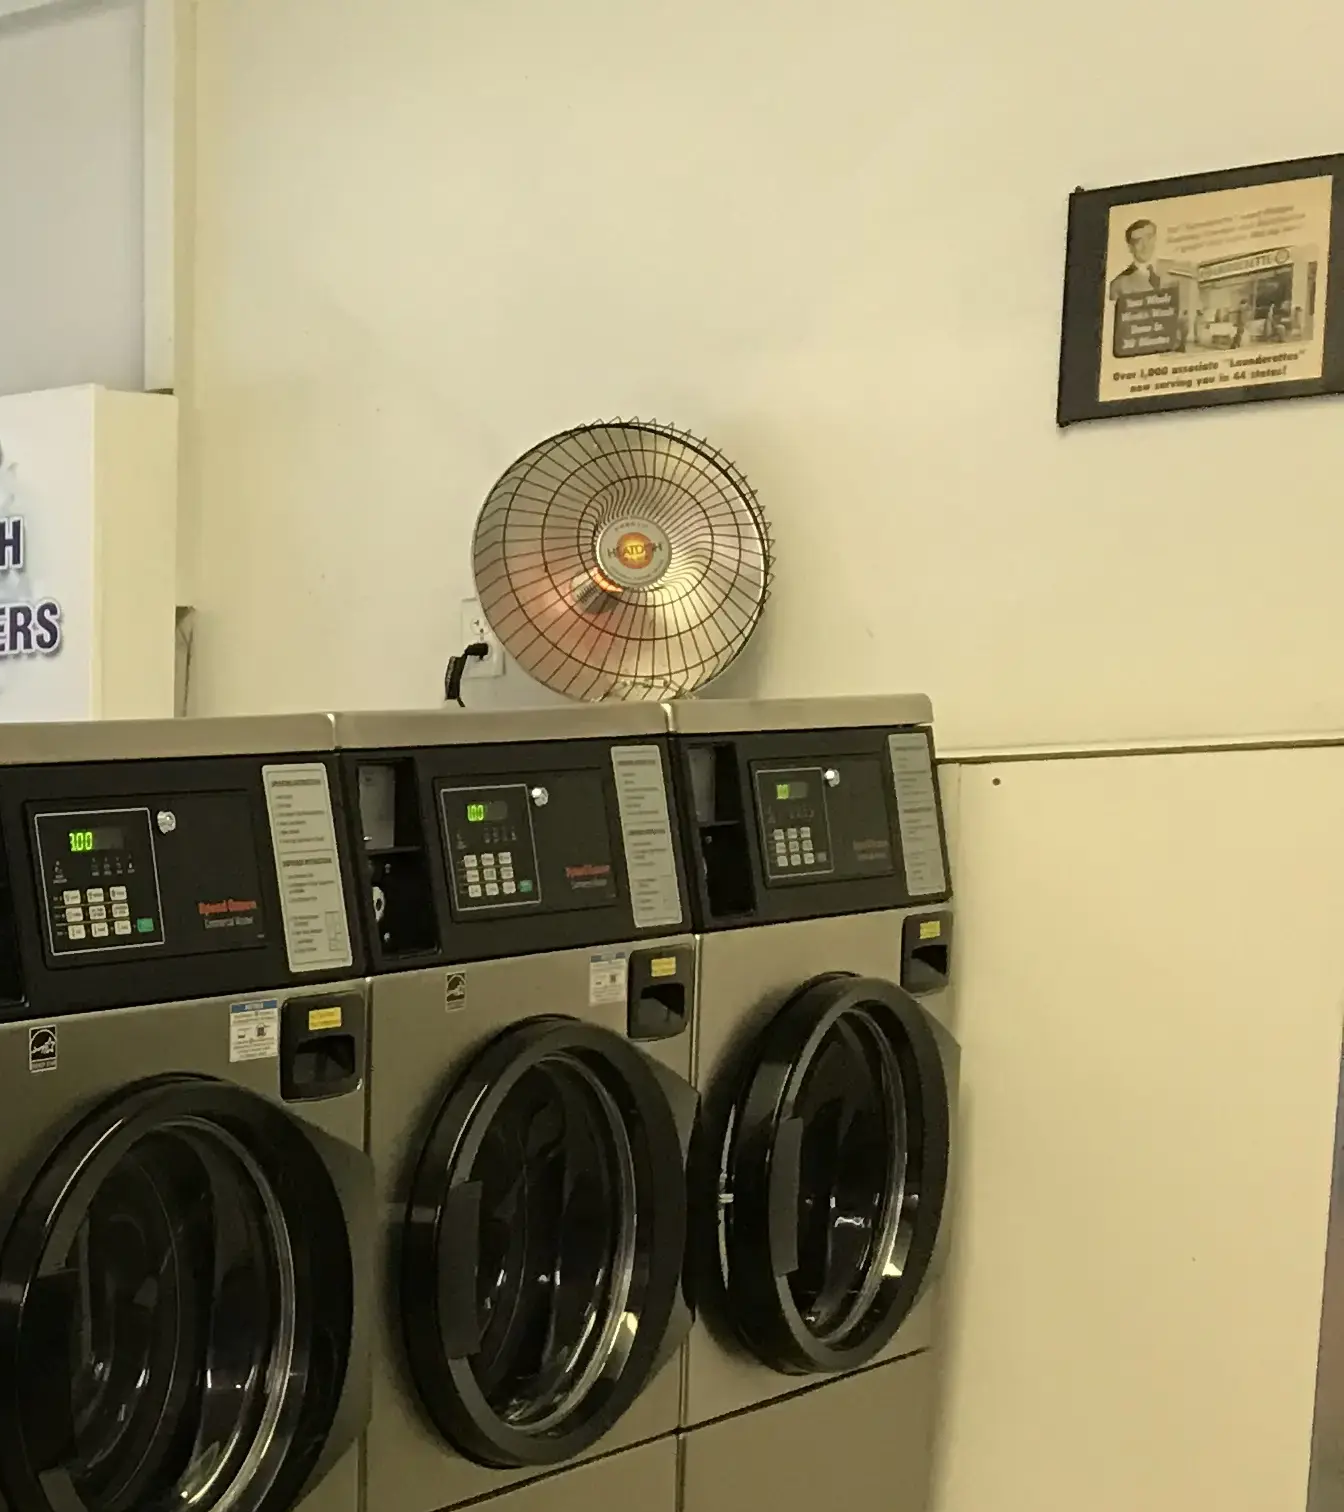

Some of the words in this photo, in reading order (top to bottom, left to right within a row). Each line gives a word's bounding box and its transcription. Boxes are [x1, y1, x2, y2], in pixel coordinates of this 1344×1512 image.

[1113, 371, 1136, 381] Over
[1172, 361, 1219, 375] associate
[1130, 384, 1150, 393] now
[1155, 378, 1192, 391] serving
[1196, 376, 1215, 387] you
[1219, 373, 1229, 382] in
